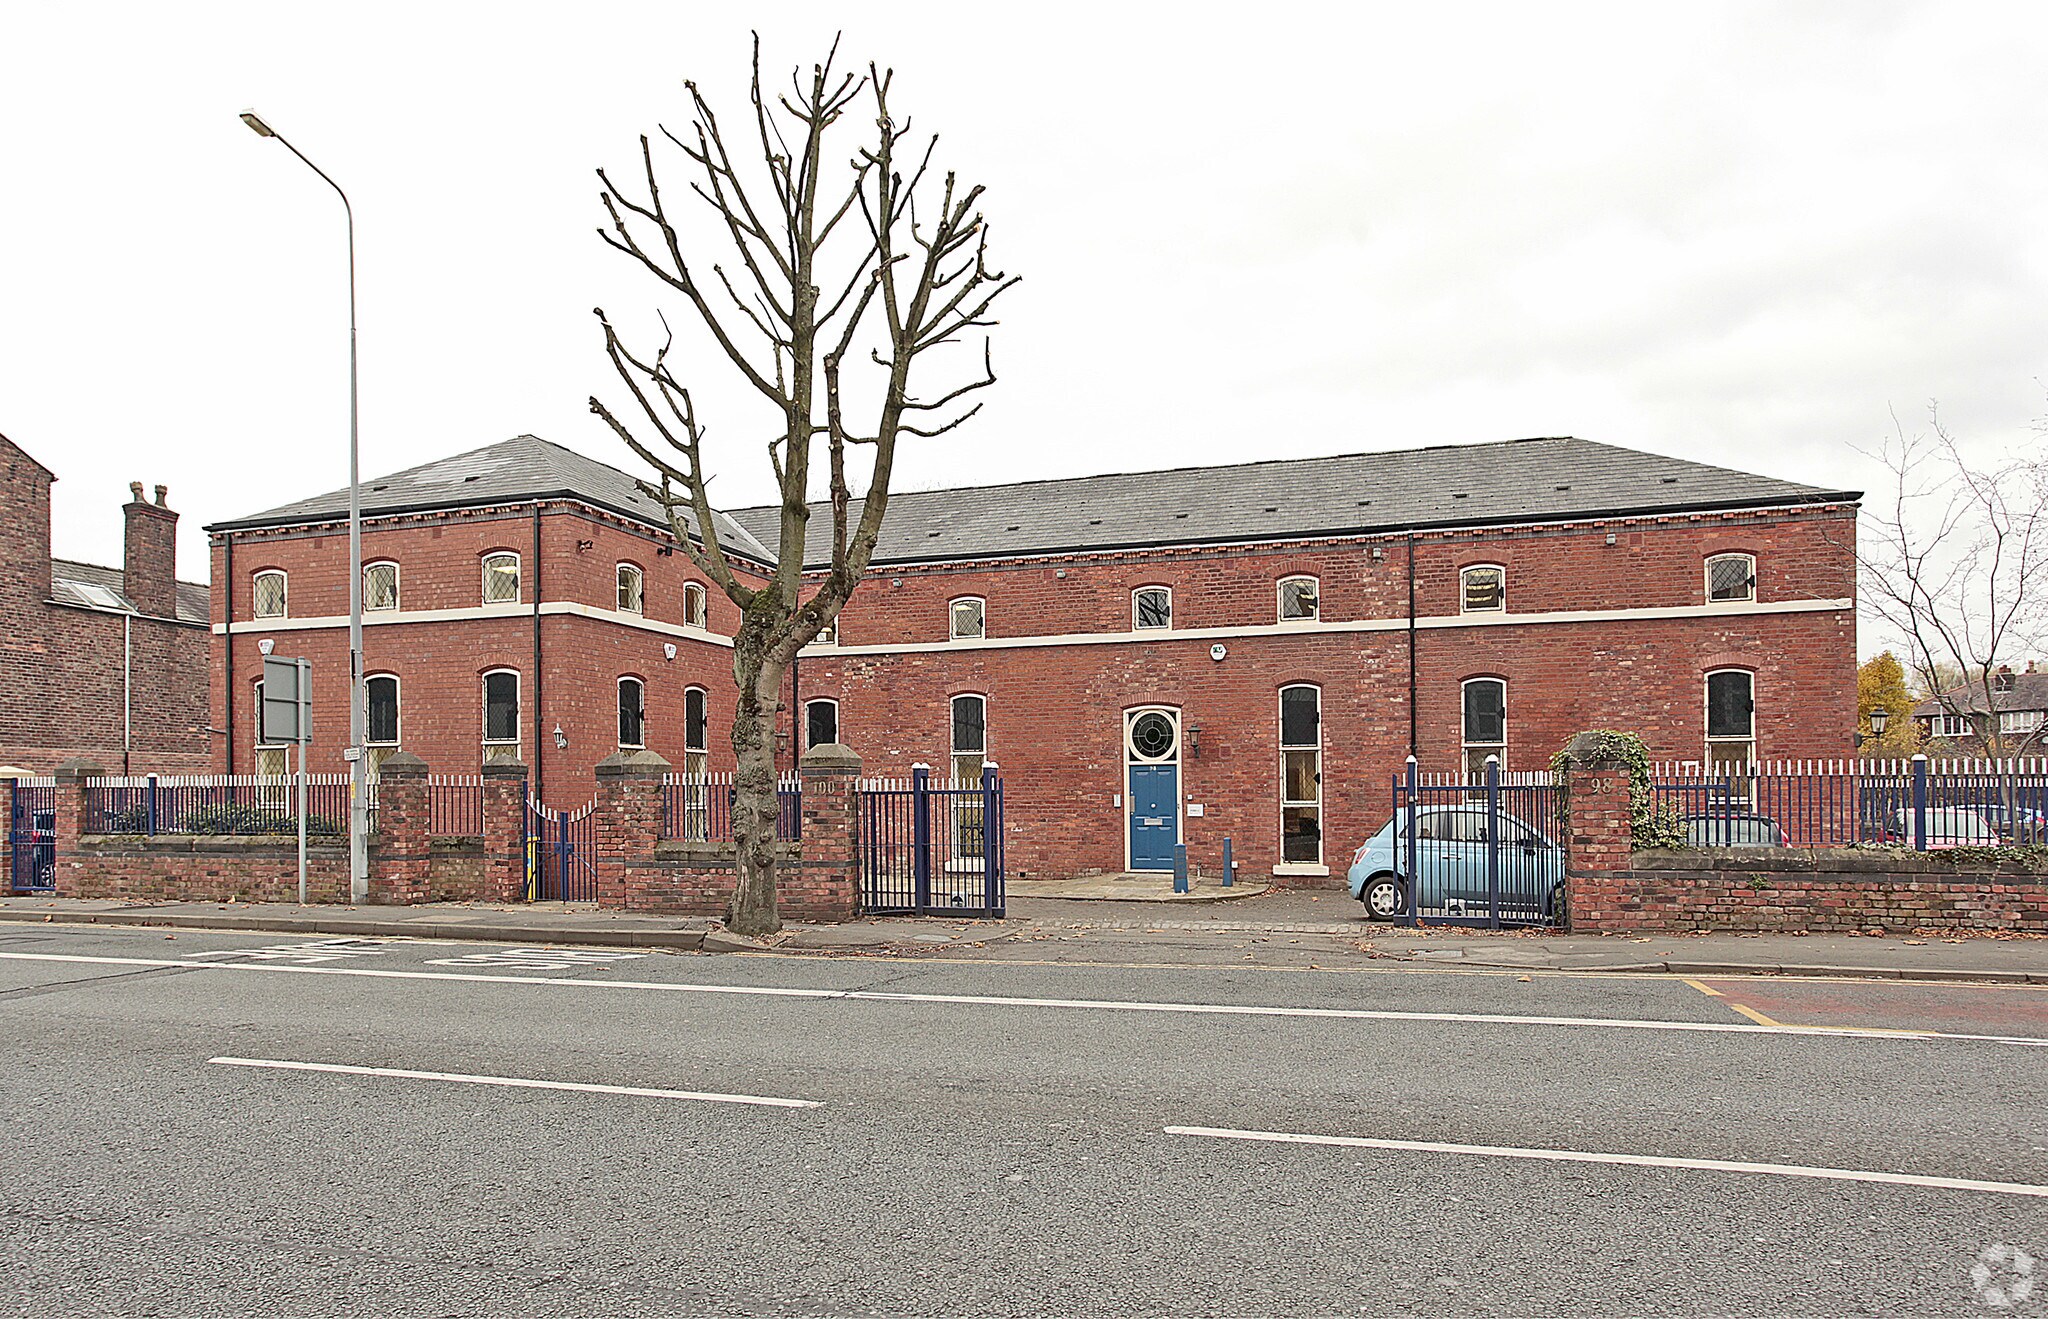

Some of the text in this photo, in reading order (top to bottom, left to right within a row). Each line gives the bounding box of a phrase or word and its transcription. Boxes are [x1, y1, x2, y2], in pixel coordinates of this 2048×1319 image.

[813, 781, 835, 795] 100
[1591, 778, 1613, 793] 98
[180, 938, 458, 964] LANE
[423, 949, 647, 971] BUS
